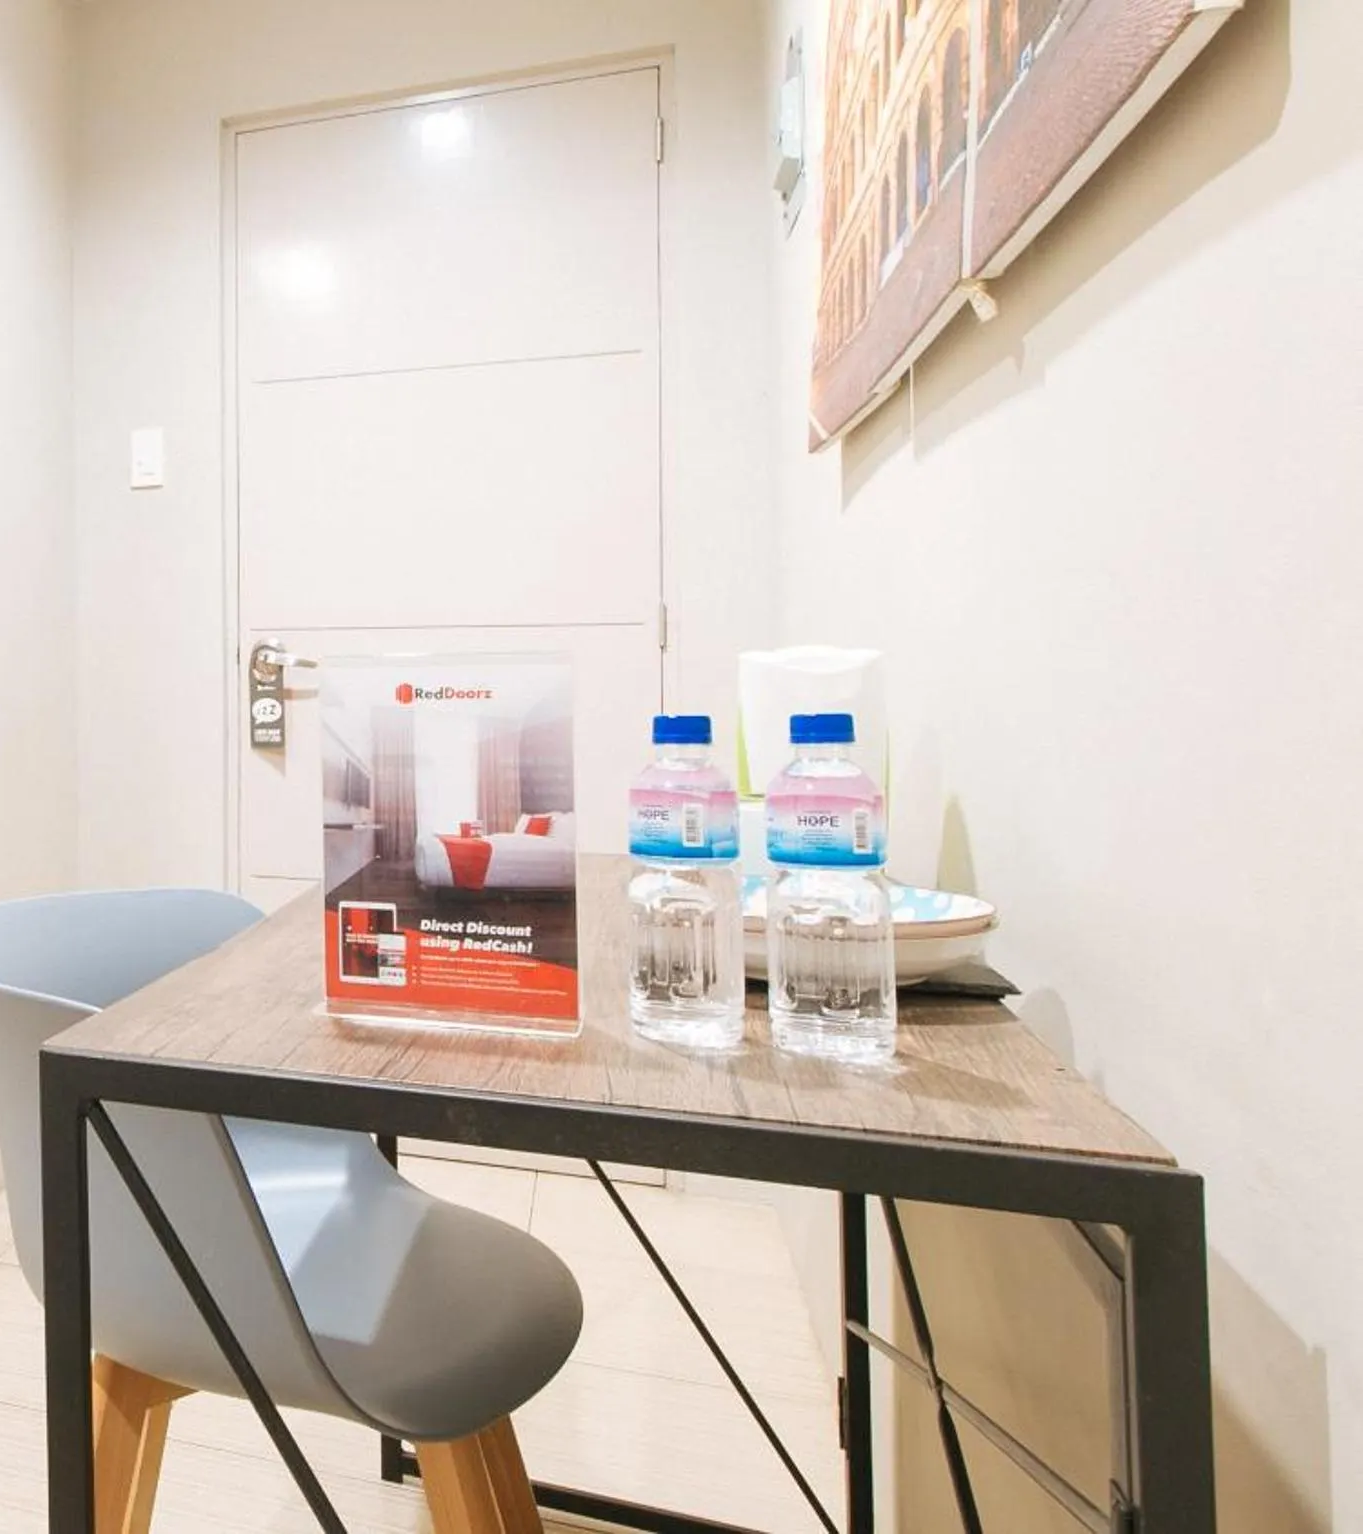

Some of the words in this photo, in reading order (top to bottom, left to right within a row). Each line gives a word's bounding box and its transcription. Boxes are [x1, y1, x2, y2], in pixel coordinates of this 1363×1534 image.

[415, 686, 493, 700] RedDoorz
[637, 809, 670, 821] HOPE
[797, 815, 840, 828] HOPE
[420, 919, 465, 933] Direct
[466, 921, 532, 937] Discount
[420, 936, 460, 952] using
[462, 937, 533, 954] RedCash!
